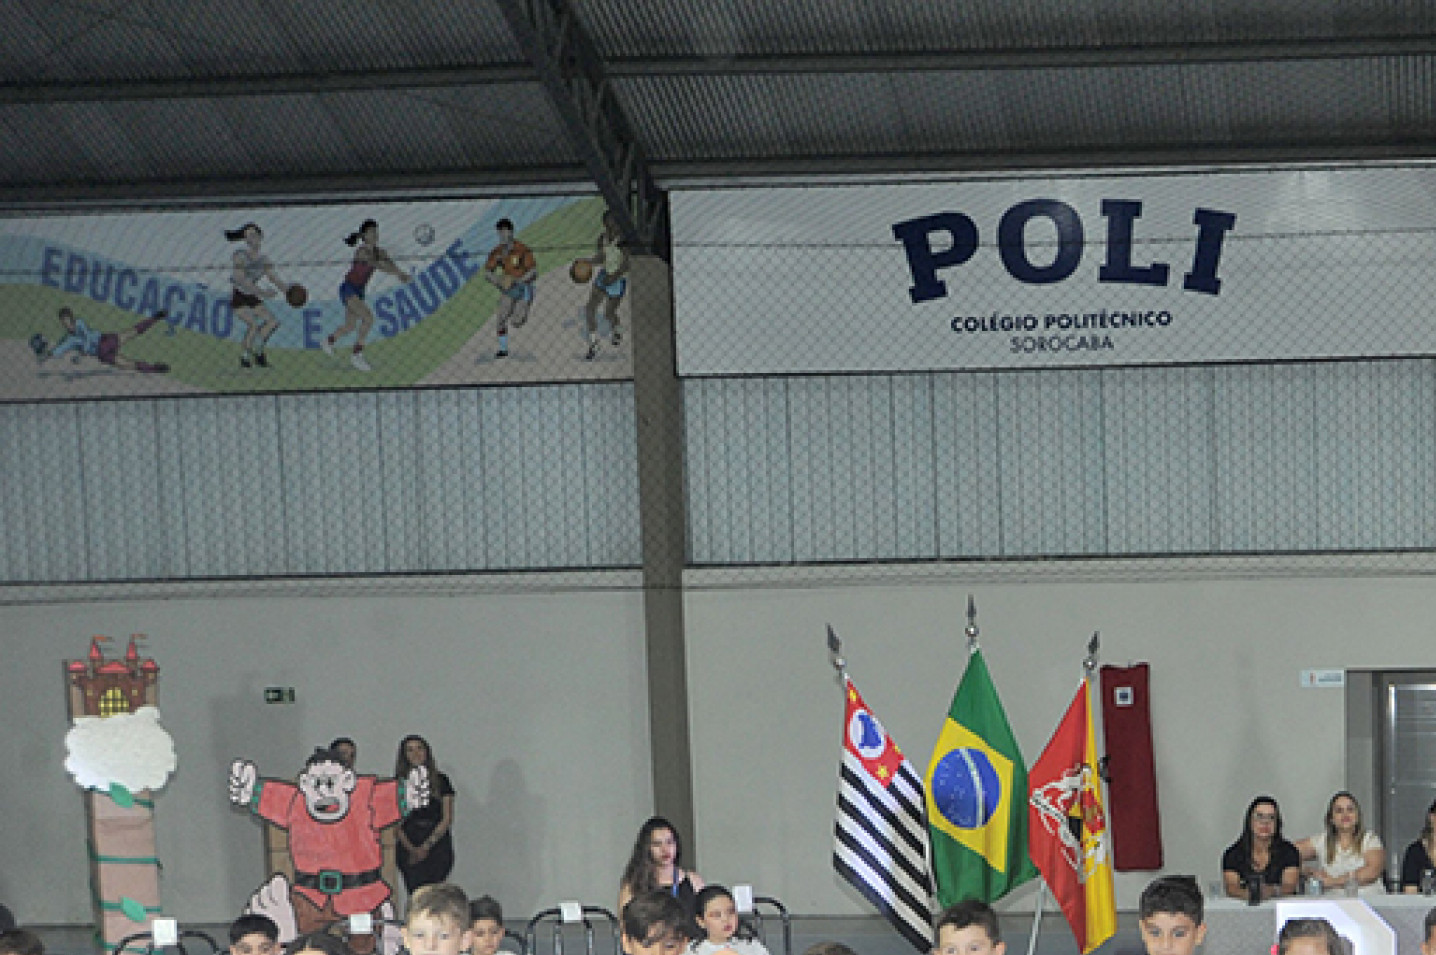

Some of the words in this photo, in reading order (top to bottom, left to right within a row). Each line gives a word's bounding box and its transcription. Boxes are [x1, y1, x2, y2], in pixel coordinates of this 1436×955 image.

[892, 198, 1237, 304] POLI
[42, 246, 233, 339] EDUCAÇÃO
[303, 308, 322, 348] E
[375, 237, 480, 338] SAÚDE
[950, 312, 1038, 333] COLÉGIO
[1043, 309, 1173, 330] POLITÉCNICO
[1009, 335, 1114, 353] SOROCABA
